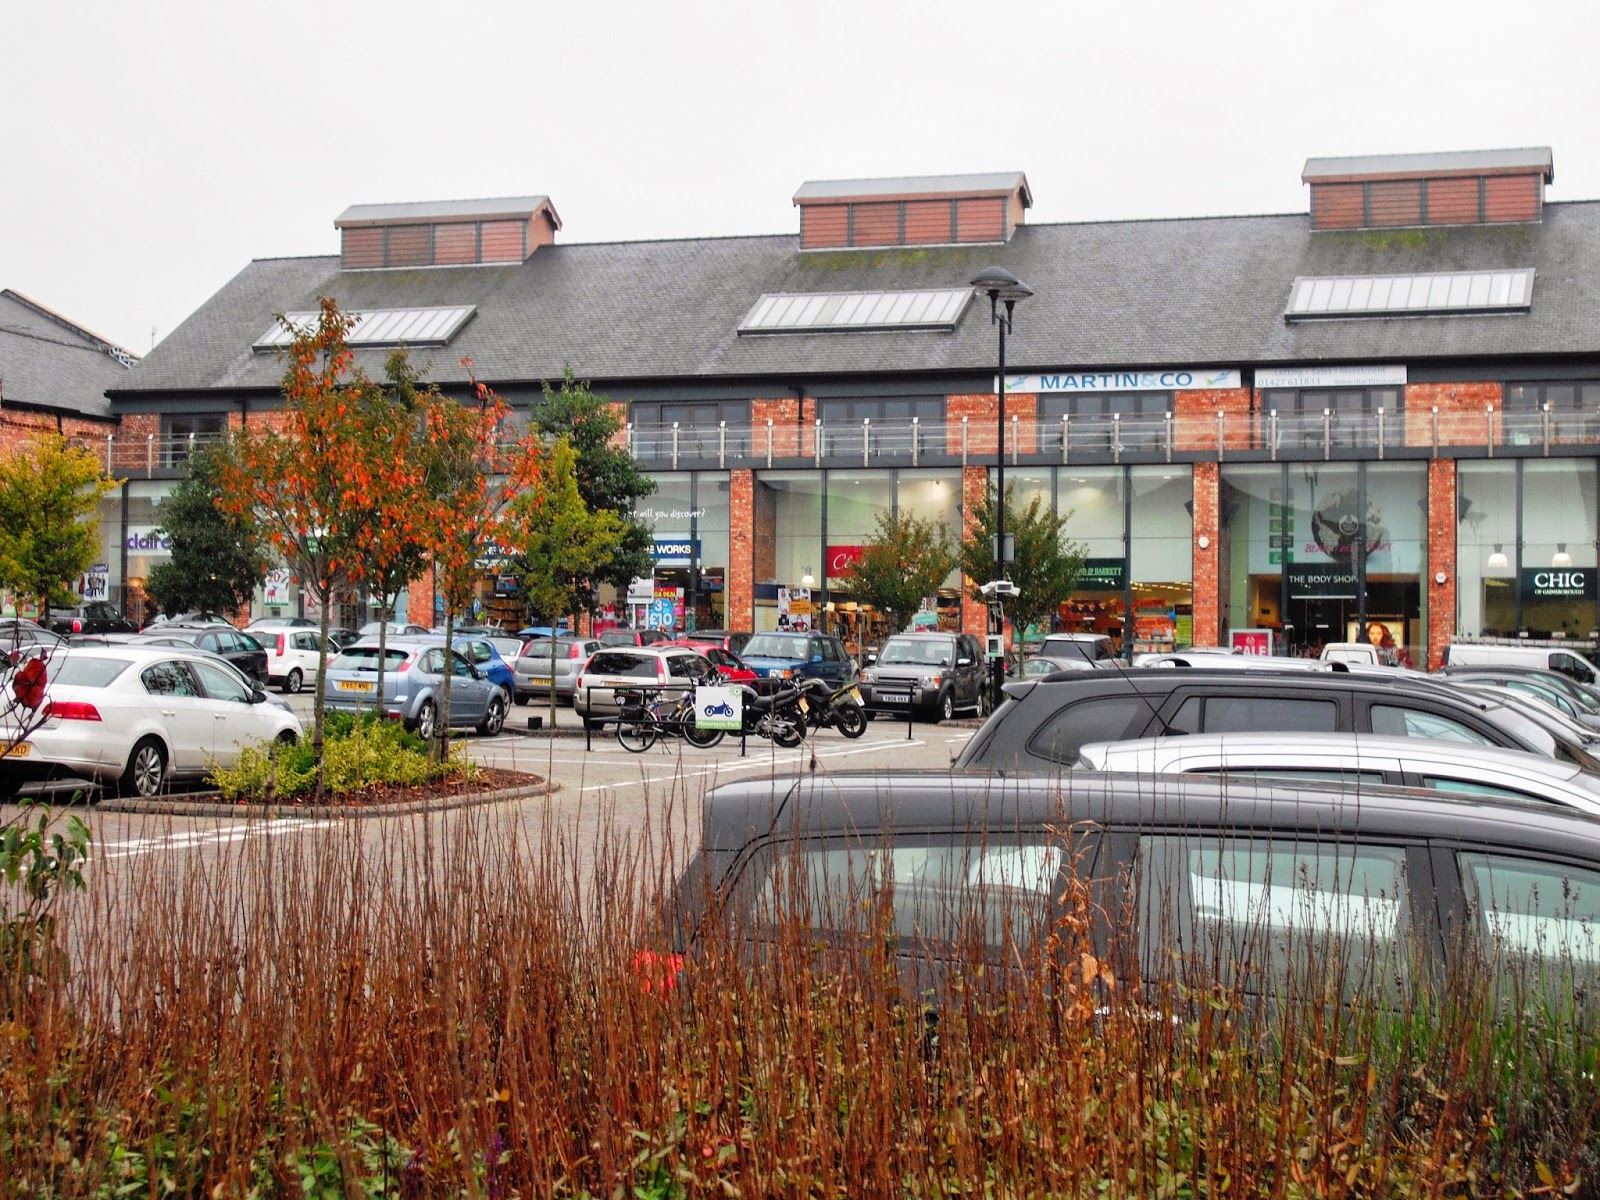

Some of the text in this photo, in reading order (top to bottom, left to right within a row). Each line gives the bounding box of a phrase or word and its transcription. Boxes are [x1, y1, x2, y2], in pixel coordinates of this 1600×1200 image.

[1040, 371, 1194, 390] MARTIN&CO
[1258, 378, 1286, 387] 01427
[639, 508, 653, 519] will
[655, 511, 669, 521] you
[670, 507, 706, 519] discover?
[126, 533, 173, 550] claire
[656, 545, 692, 555] WORKS
[1288, 575, 1306, 584] THE
[1307, 575, 1332, 584] BODY
[1534, 572, 1585, 588] CHIC
[654, 599, 663, 612] 3
[649, 612, 673, 626] £10
[1234, 645, 1267, 656] SALE
[727, 720, 740, 728] Park
